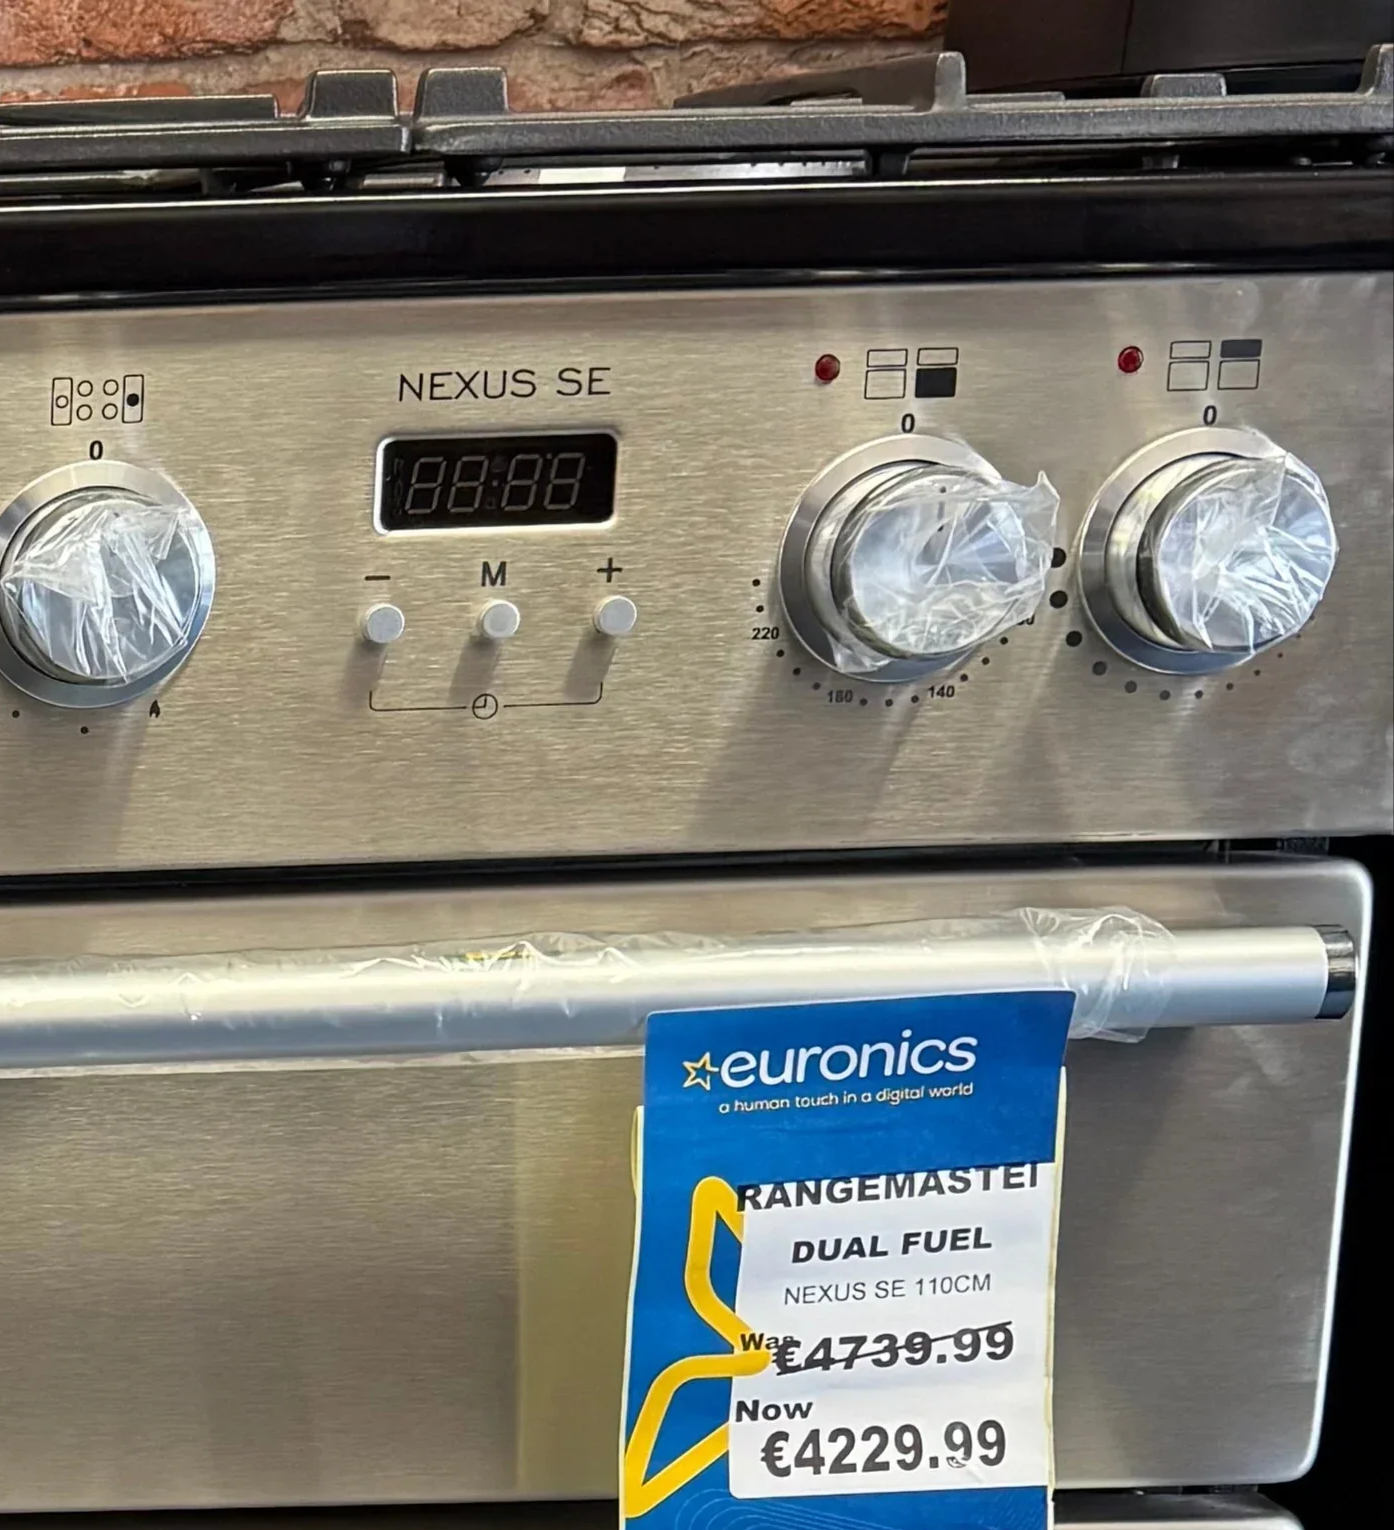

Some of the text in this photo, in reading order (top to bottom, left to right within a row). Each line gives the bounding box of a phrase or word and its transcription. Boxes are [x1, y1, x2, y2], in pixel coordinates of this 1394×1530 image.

[398, 367, 612, 402] NEXUS SE
[900, 412, 916, 434] 0
[1202, 404, 1218, 426] 0
[88, 439, 103, 461] 0
[481, 561, 507, 587] M
[752, 626, 779, 640] 220
[927, 684, 956, 699] 140
[719, 1028, 978, 1091] euronics
[718, 1081, 974, 1114] a human touch in a digital world
[792, 1227, 992, 1263] DUAL FUEL
[784, 1274, 991, 1305] NEXUS SE 110CM
[771, 1322, 1014, 1375] €4739.99
[735, 1400, 813, 1422] Now
[760, 1419, 1006, 1478] €4229.99
